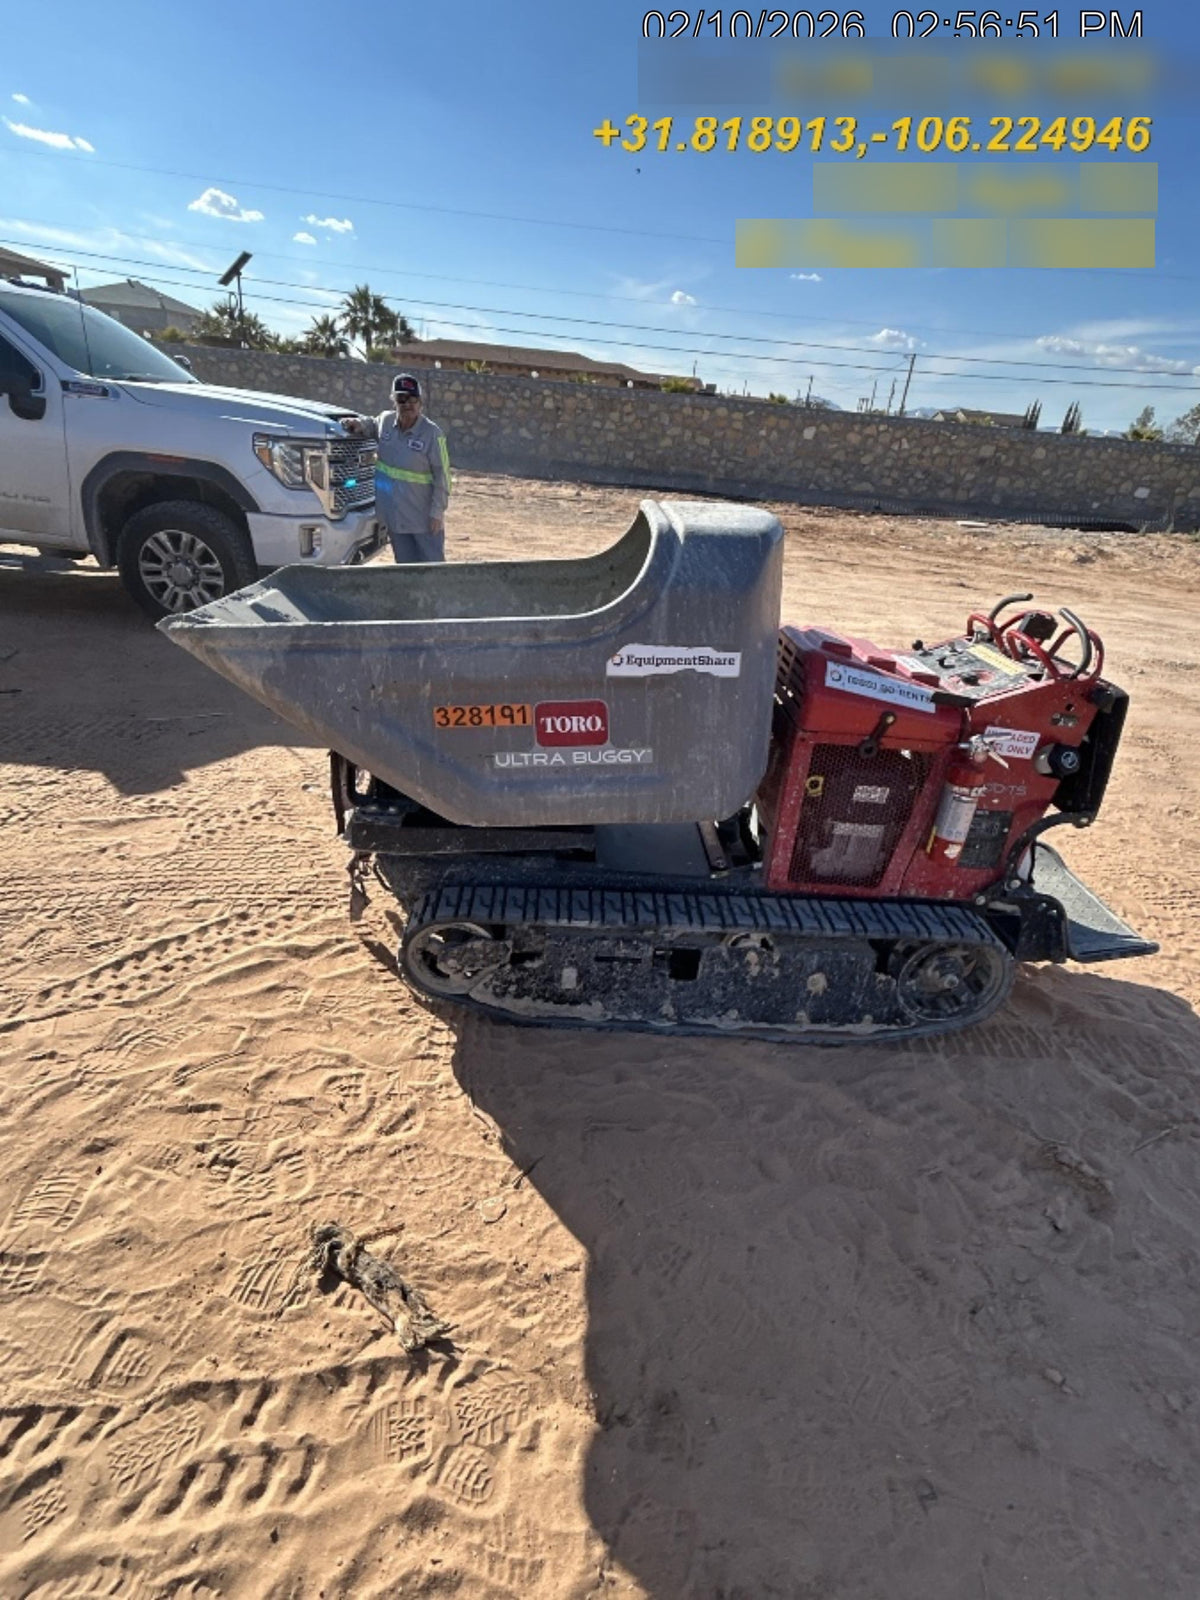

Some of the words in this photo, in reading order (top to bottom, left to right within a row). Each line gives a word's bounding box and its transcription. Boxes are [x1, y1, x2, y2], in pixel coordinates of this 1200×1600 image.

[625, 654, 736, 668] EquipmentShare
[435, 704, 529, 727] 328191
[540, 713, 605, 734] TORO
[494, 751, 566, 767] ULTRA
[572, 749, 644, 764] BUGGY
